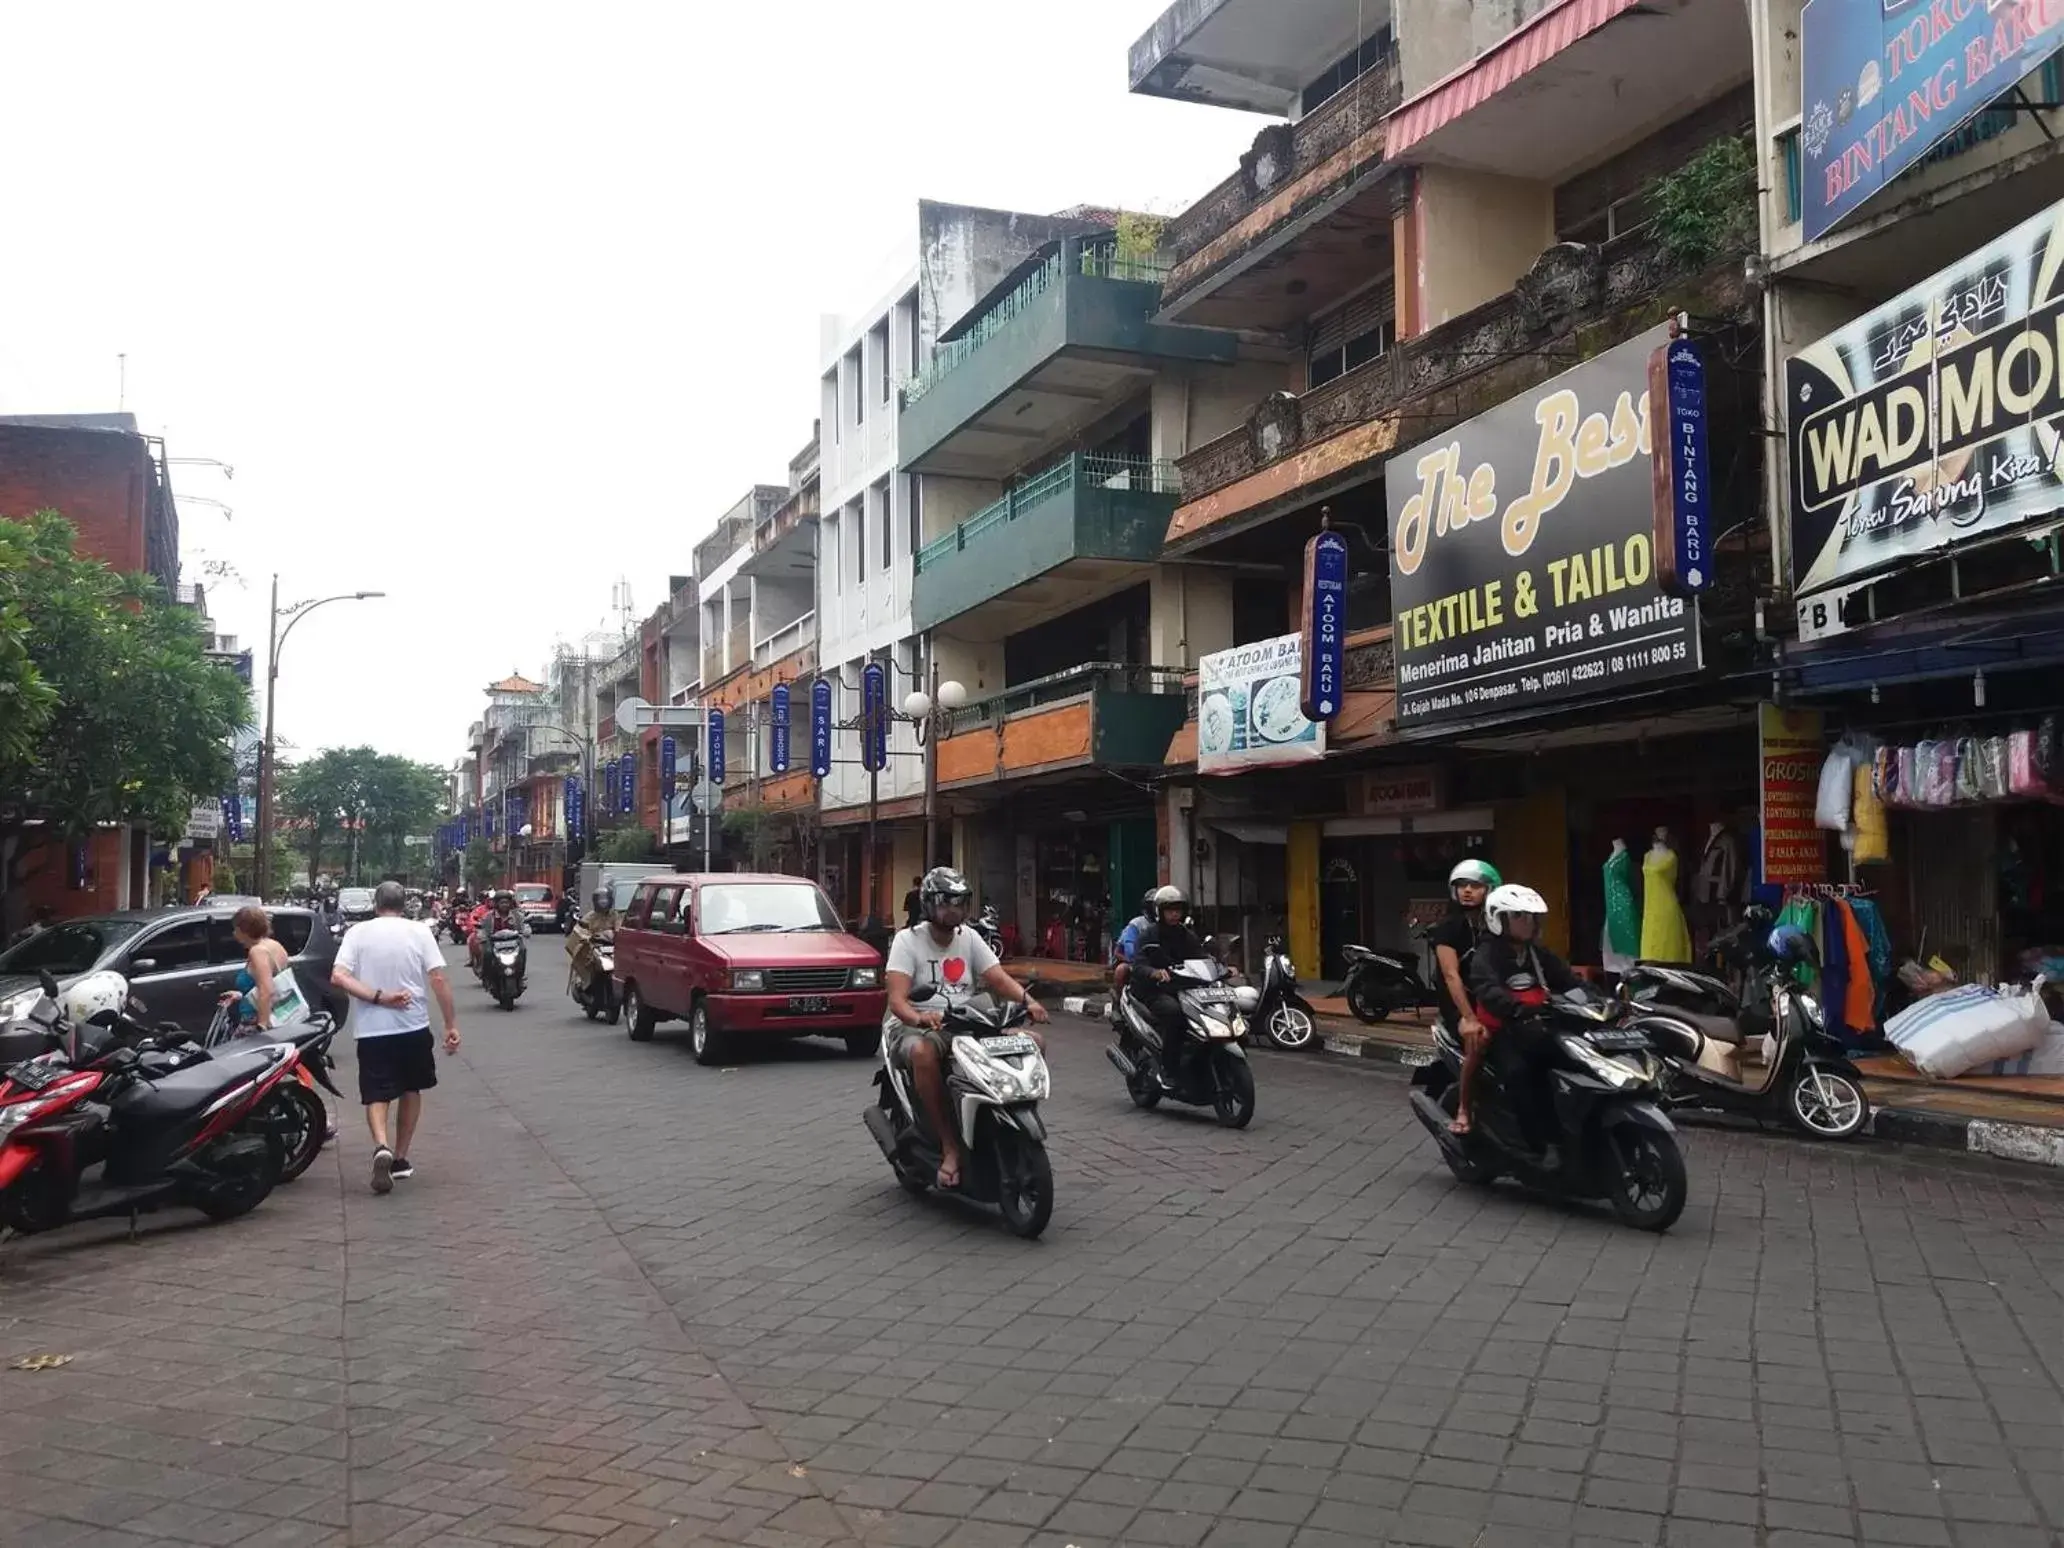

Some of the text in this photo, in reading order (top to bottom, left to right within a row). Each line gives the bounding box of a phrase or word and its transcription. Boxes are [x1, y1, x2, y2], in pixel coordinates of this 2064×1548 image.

[1825, 58, 1957, 206] BINTANG
[1676, 407, 1700, 418] TOKO
[1808, 313, 2064, 494] WADIMO
[1395, 441, 1497, 575] The
[1683, 422, 1700, 561] BINTANG BARU
[1321, 594, 1335, 693] ATOOM BARU
[1399, 533, 1651, 650] TEXTILE & TAILO
[1400, 595, 1684, 684] Menerima Jahitan Pria & Wanita
[1227, 647, 1274, 669] ATOOM
[1411, 698, 1431, 716] Gajah
[1431, 695, 1451, 711] Mada
[1543, 668, 1571, 690] (0361)
[1571, 660, 1605, 681] 422623
[1611, 656, 1625, 673] 08
[1626, 650, 1649, 669] 1111
[1651, 645, 1671, 664] 800
[1672, 641, 1687, 660] 55
